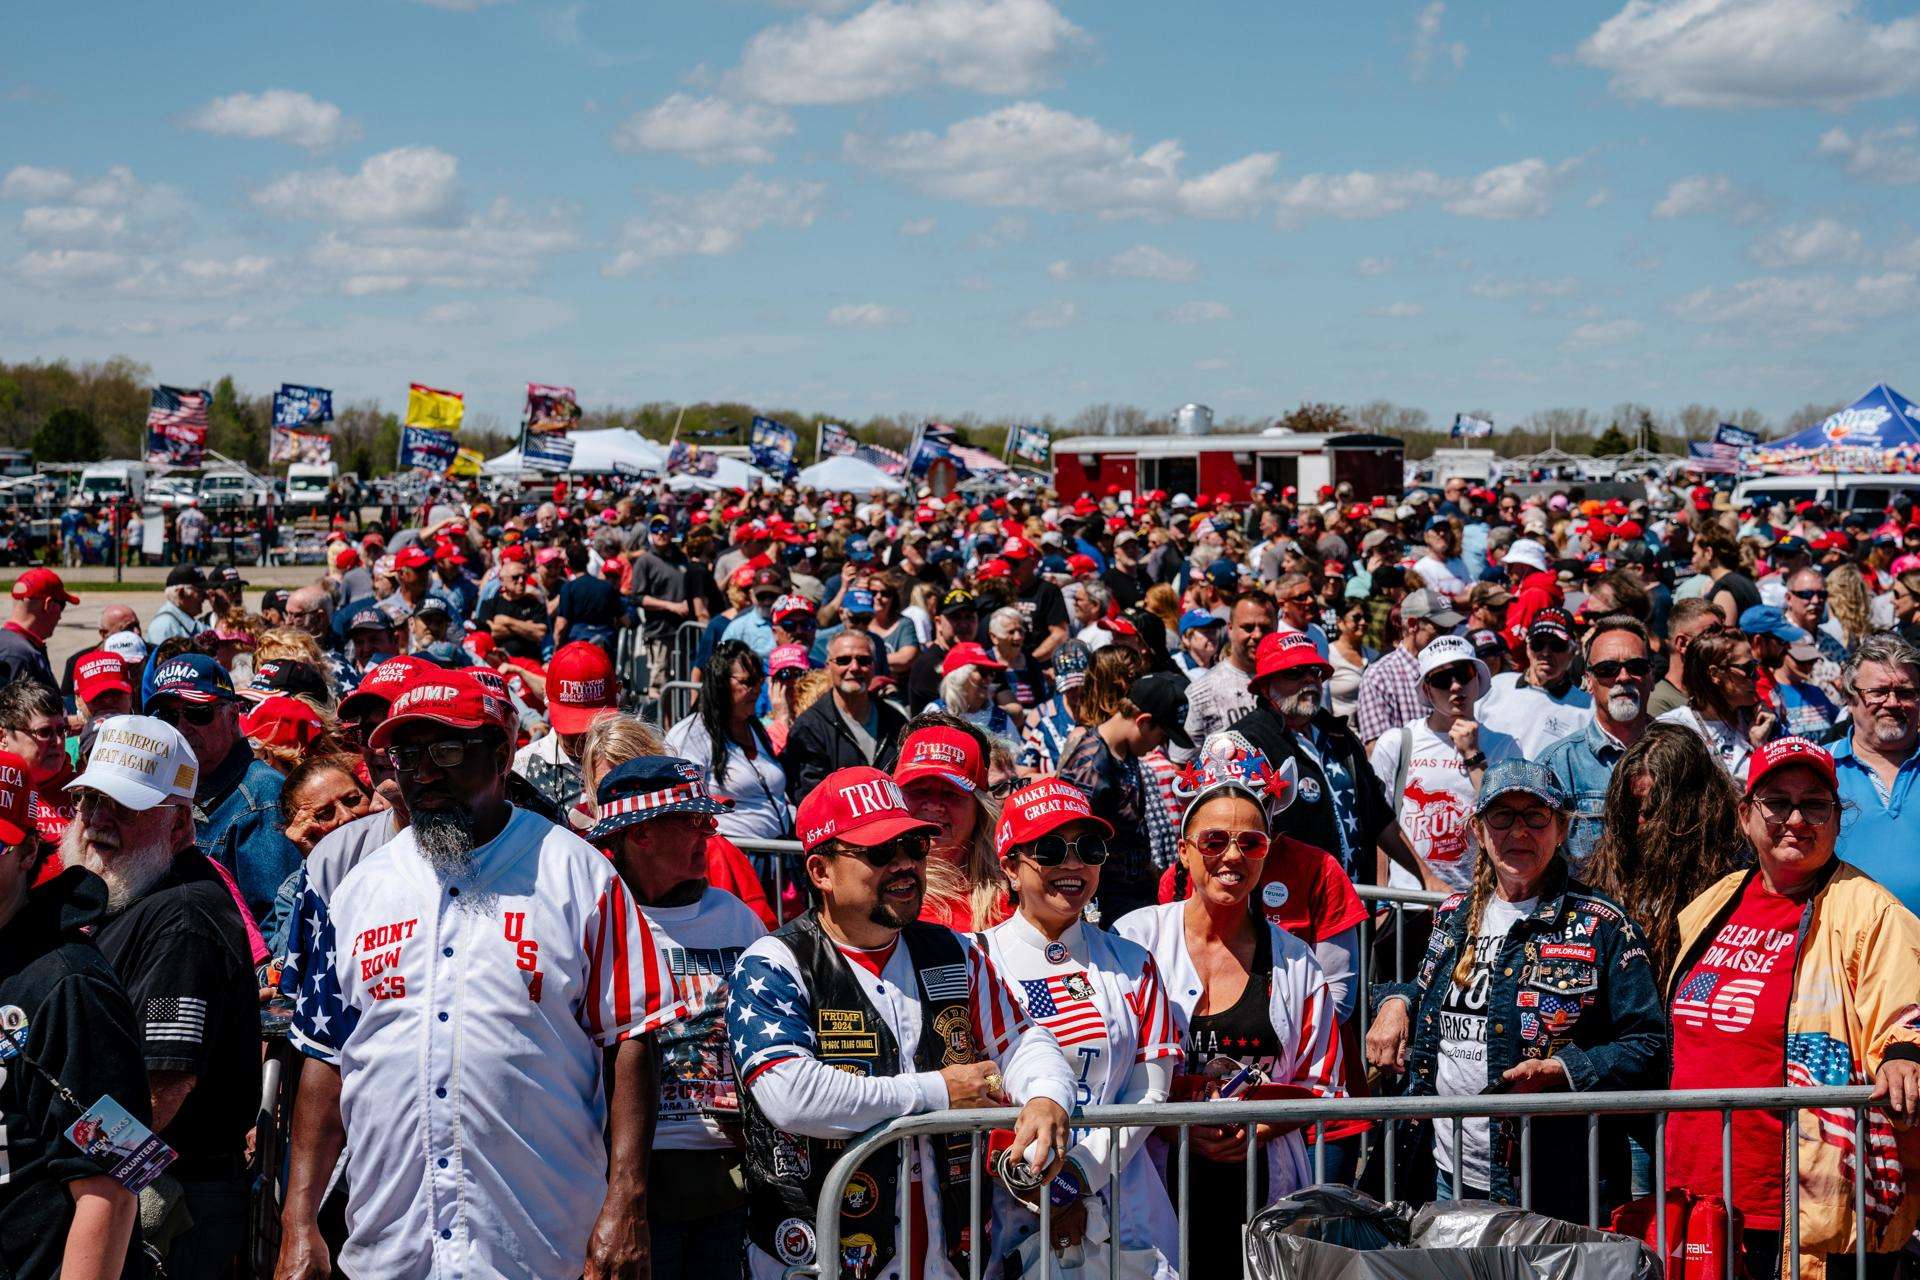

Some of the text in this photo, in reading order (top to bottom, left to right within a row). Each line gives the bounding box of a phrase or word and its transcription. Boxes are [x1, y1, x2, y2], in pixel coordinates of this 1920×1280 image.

[1428, 636, 1463, 651] TRUMP
[79, 660, 98, 674] MAKE
[83, 666, 101, 679] GREAT
[154, 664, 199, 687] TRUMP
[377, 662, 412, 671] TRUMP
[163, 676, 182, 684] 2024
[372, 675, 406, 684] RIGHT
[559, 680, 604, 697] Trump
[393, 685, 459, 717] TRUMP
[118, 731, 170, 759] AMERICA
[914, 742, 965, 763] Trump
[1763, 736, 1826, 755] LIFEGUARD
[119, 751, 158, 776] AGAIN
[931, 753, 951, 761] 2020
[1409, 758, 1437, 768] WAS
[839, 779, 909, 818] TRUM
[1014, 786, 1048, 808] MAKE
[1024, 799, 1062, 821] GREAT
[1405, 805, 1472, 842] TRUM
[1265, 890, 1285, 898] TRUMP
[1575, 900, 1618, 921] PATRIOT
[352, 918, 418, 957] FRONT
[1764, 928, 1794, 953] UP
[1546, 948, 1592, 959] DEPLORABLE
[1702, 946, 1779, 974] ON AISLE
[361, 947, 401, 982] ROW
[1072, 989, 1096, 1000] VOTE
[1673, 971, 1765, 1033] 46
[822, 1012, 860, 1022] TRUMP
[832, 1022, 853, 1031] 2024
[856, 1039, 874, 1049] CHANNEL
[89, 1117, 131, 1155] REMARKS
[116, 1139, 160, 1180] VOLUNTEER
[1054, 1175, 1078, 1195] TRUMP
